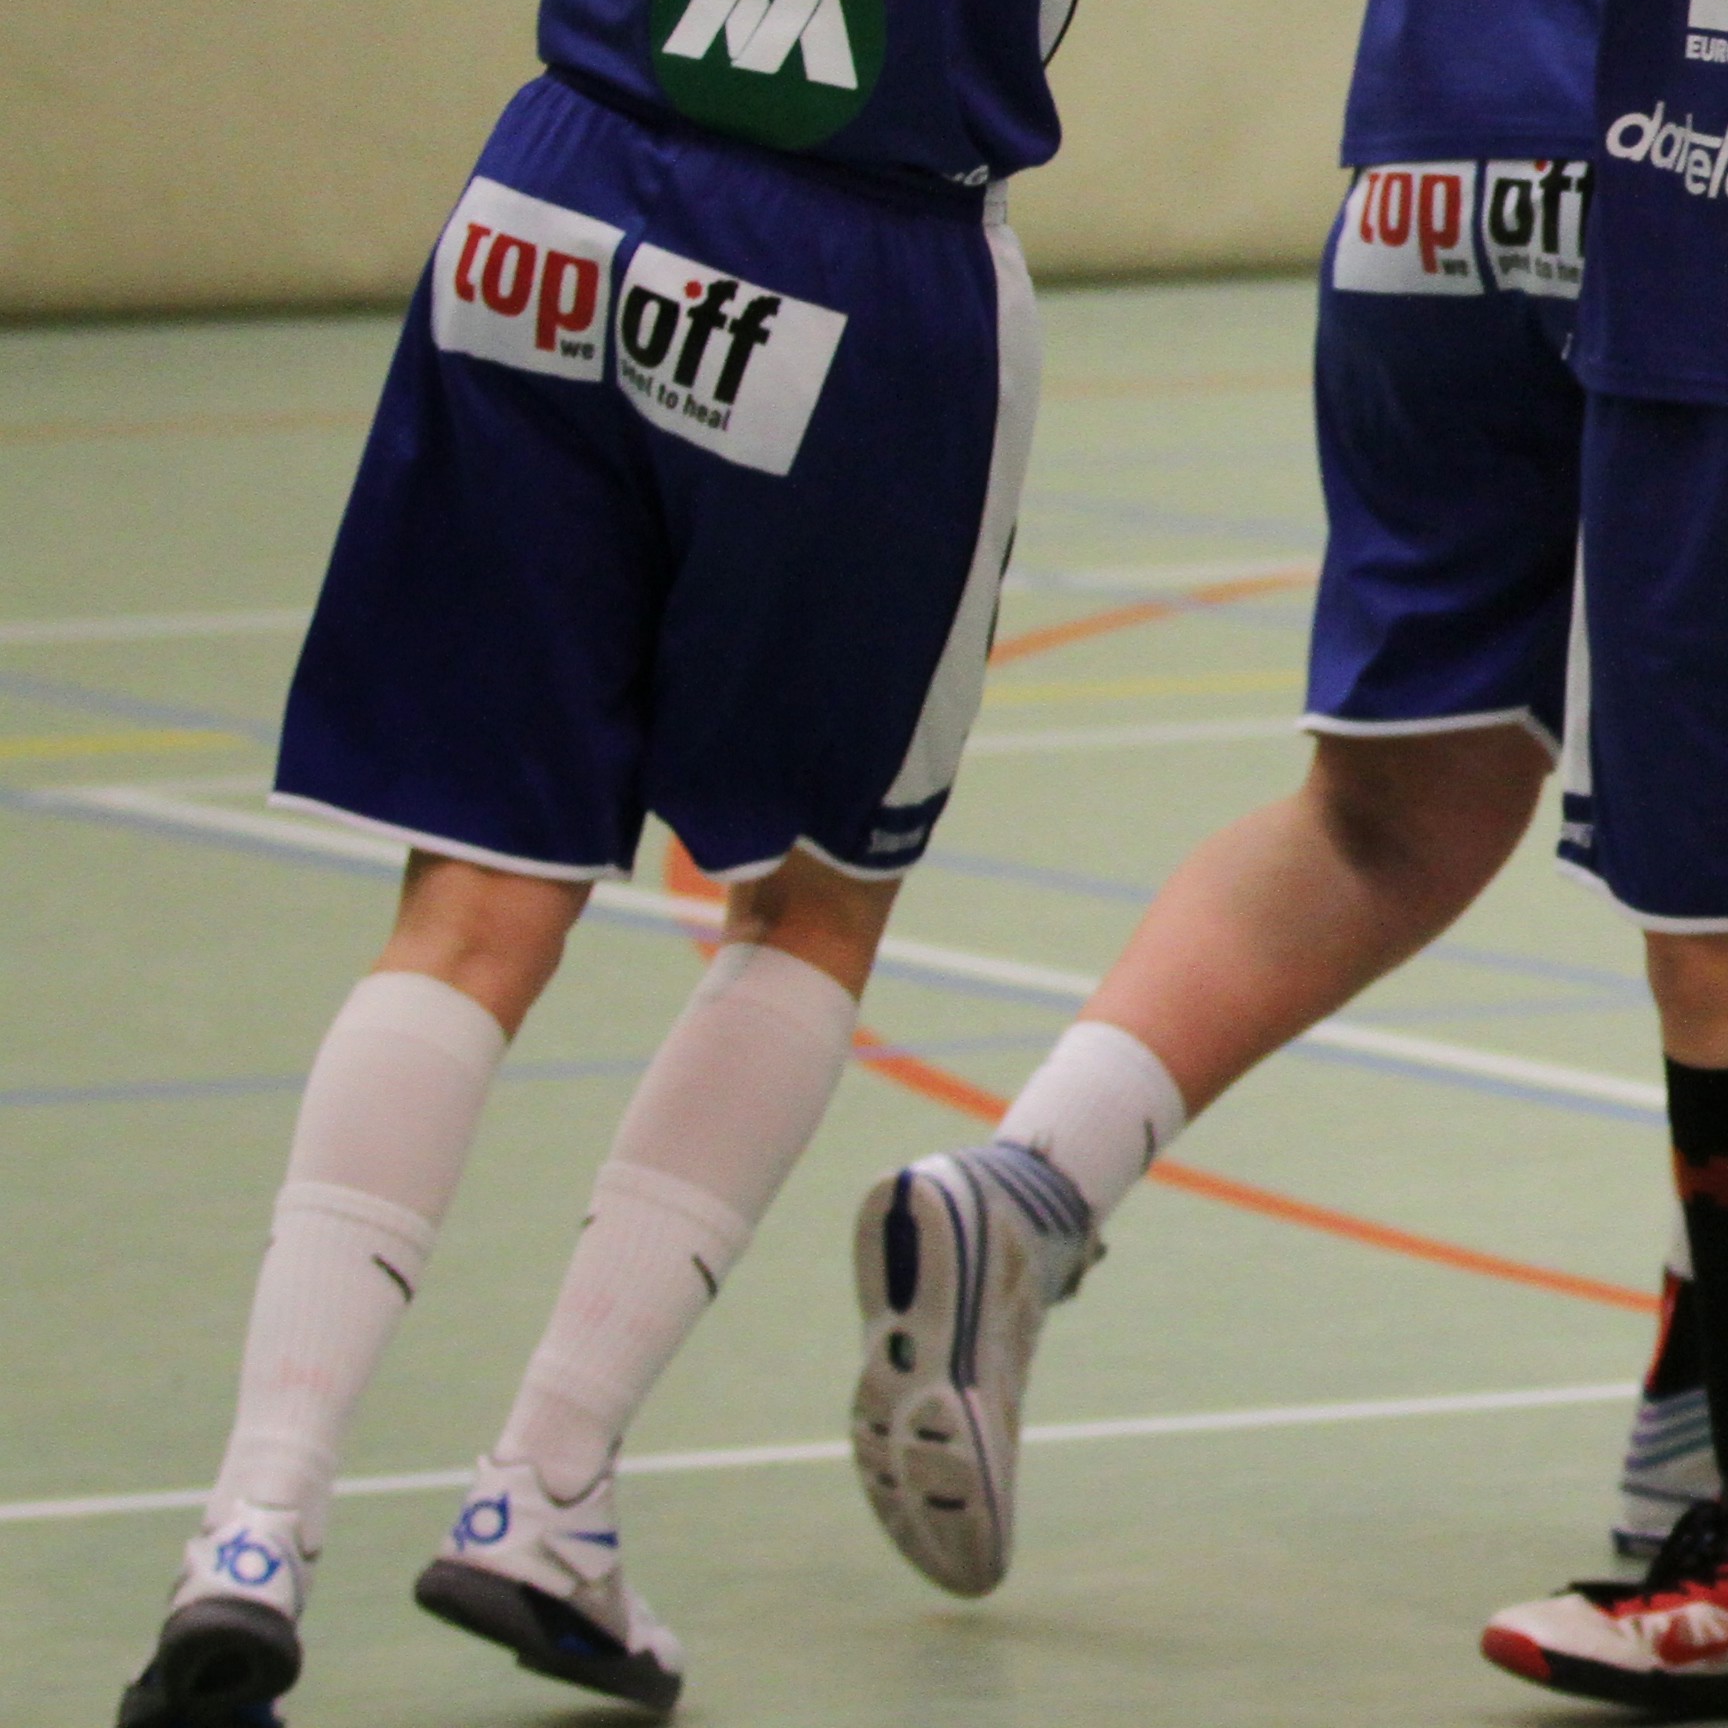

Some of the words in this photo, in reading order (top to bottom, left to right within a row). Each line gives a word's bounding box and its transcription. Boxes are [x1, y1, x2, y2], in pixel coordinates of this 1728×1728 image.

[1360, 172, 1461, 275] top
[454, 222, 600, 351] top
[621, 279, 782, 406] off
[560, 339, 596, 360] we
